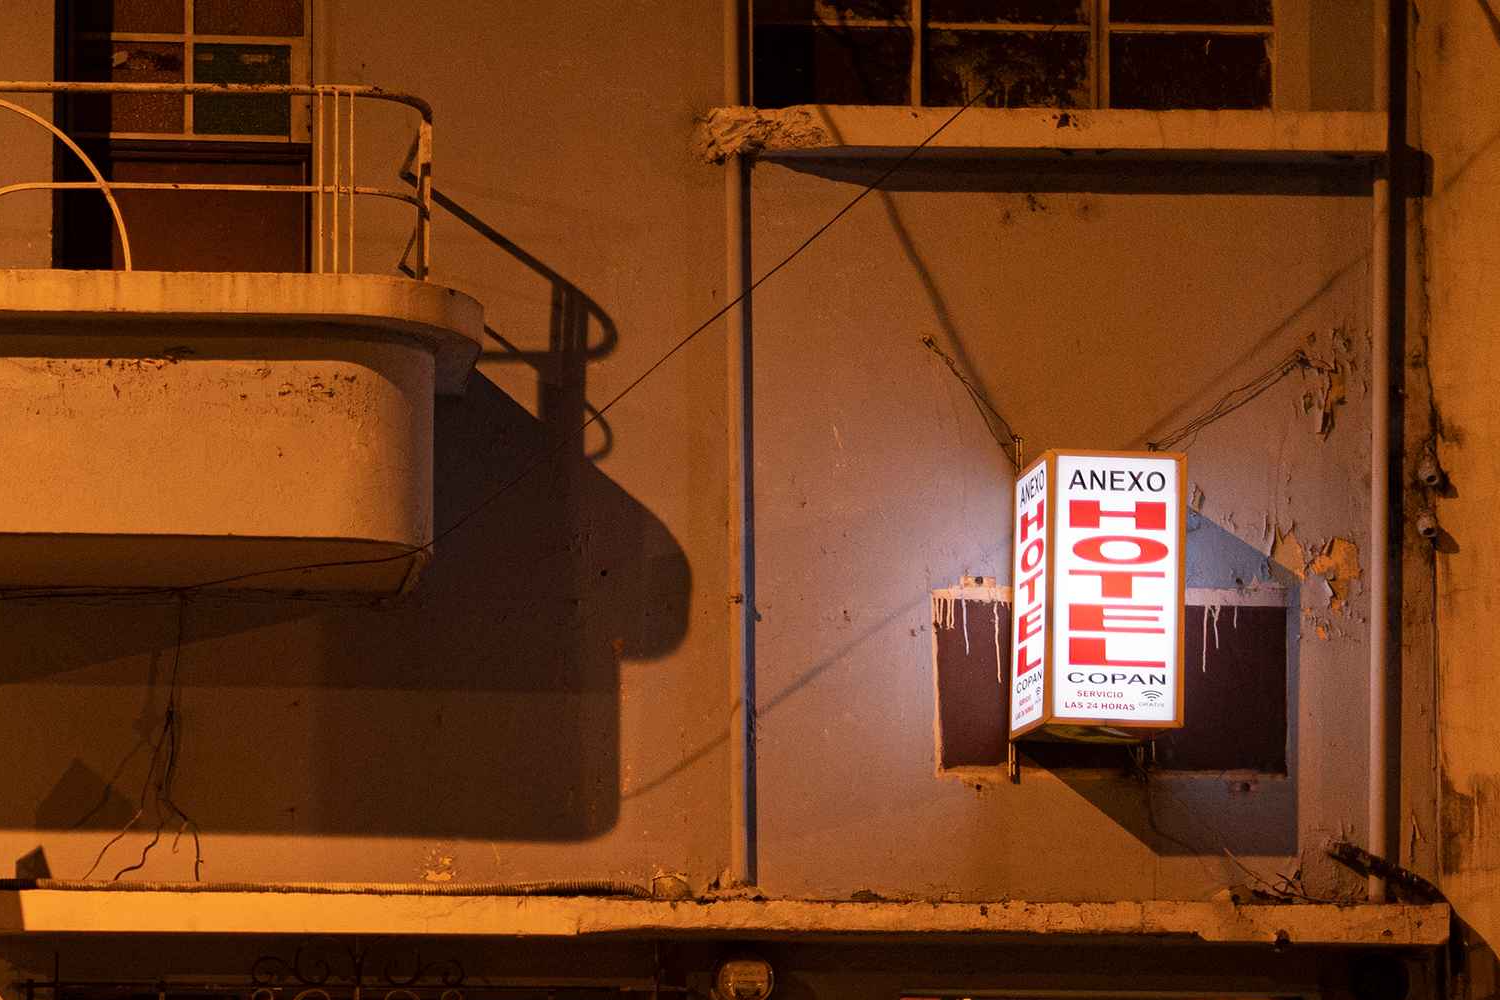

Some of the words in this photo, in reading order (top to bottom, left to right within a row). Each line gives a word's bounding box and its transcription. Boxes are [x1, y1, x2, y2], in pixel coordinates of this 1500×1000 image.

[1020, 469, 1045, 507] ANEXO
[1068, 469, 1166, 493] ANEXO
[1016, 499, 1045, 677] HOTEL
[1068, 499, 1169, 669] HOTEL
[1016, 670, 1043, 694] COPAN
[1067, 671, 1167, 686] COPAN
[1064, 701, 1084, 709] LAS
[1101, 702, 1136, 711] HORAS
[1076, 689, 1124, 699] SERVICIO
